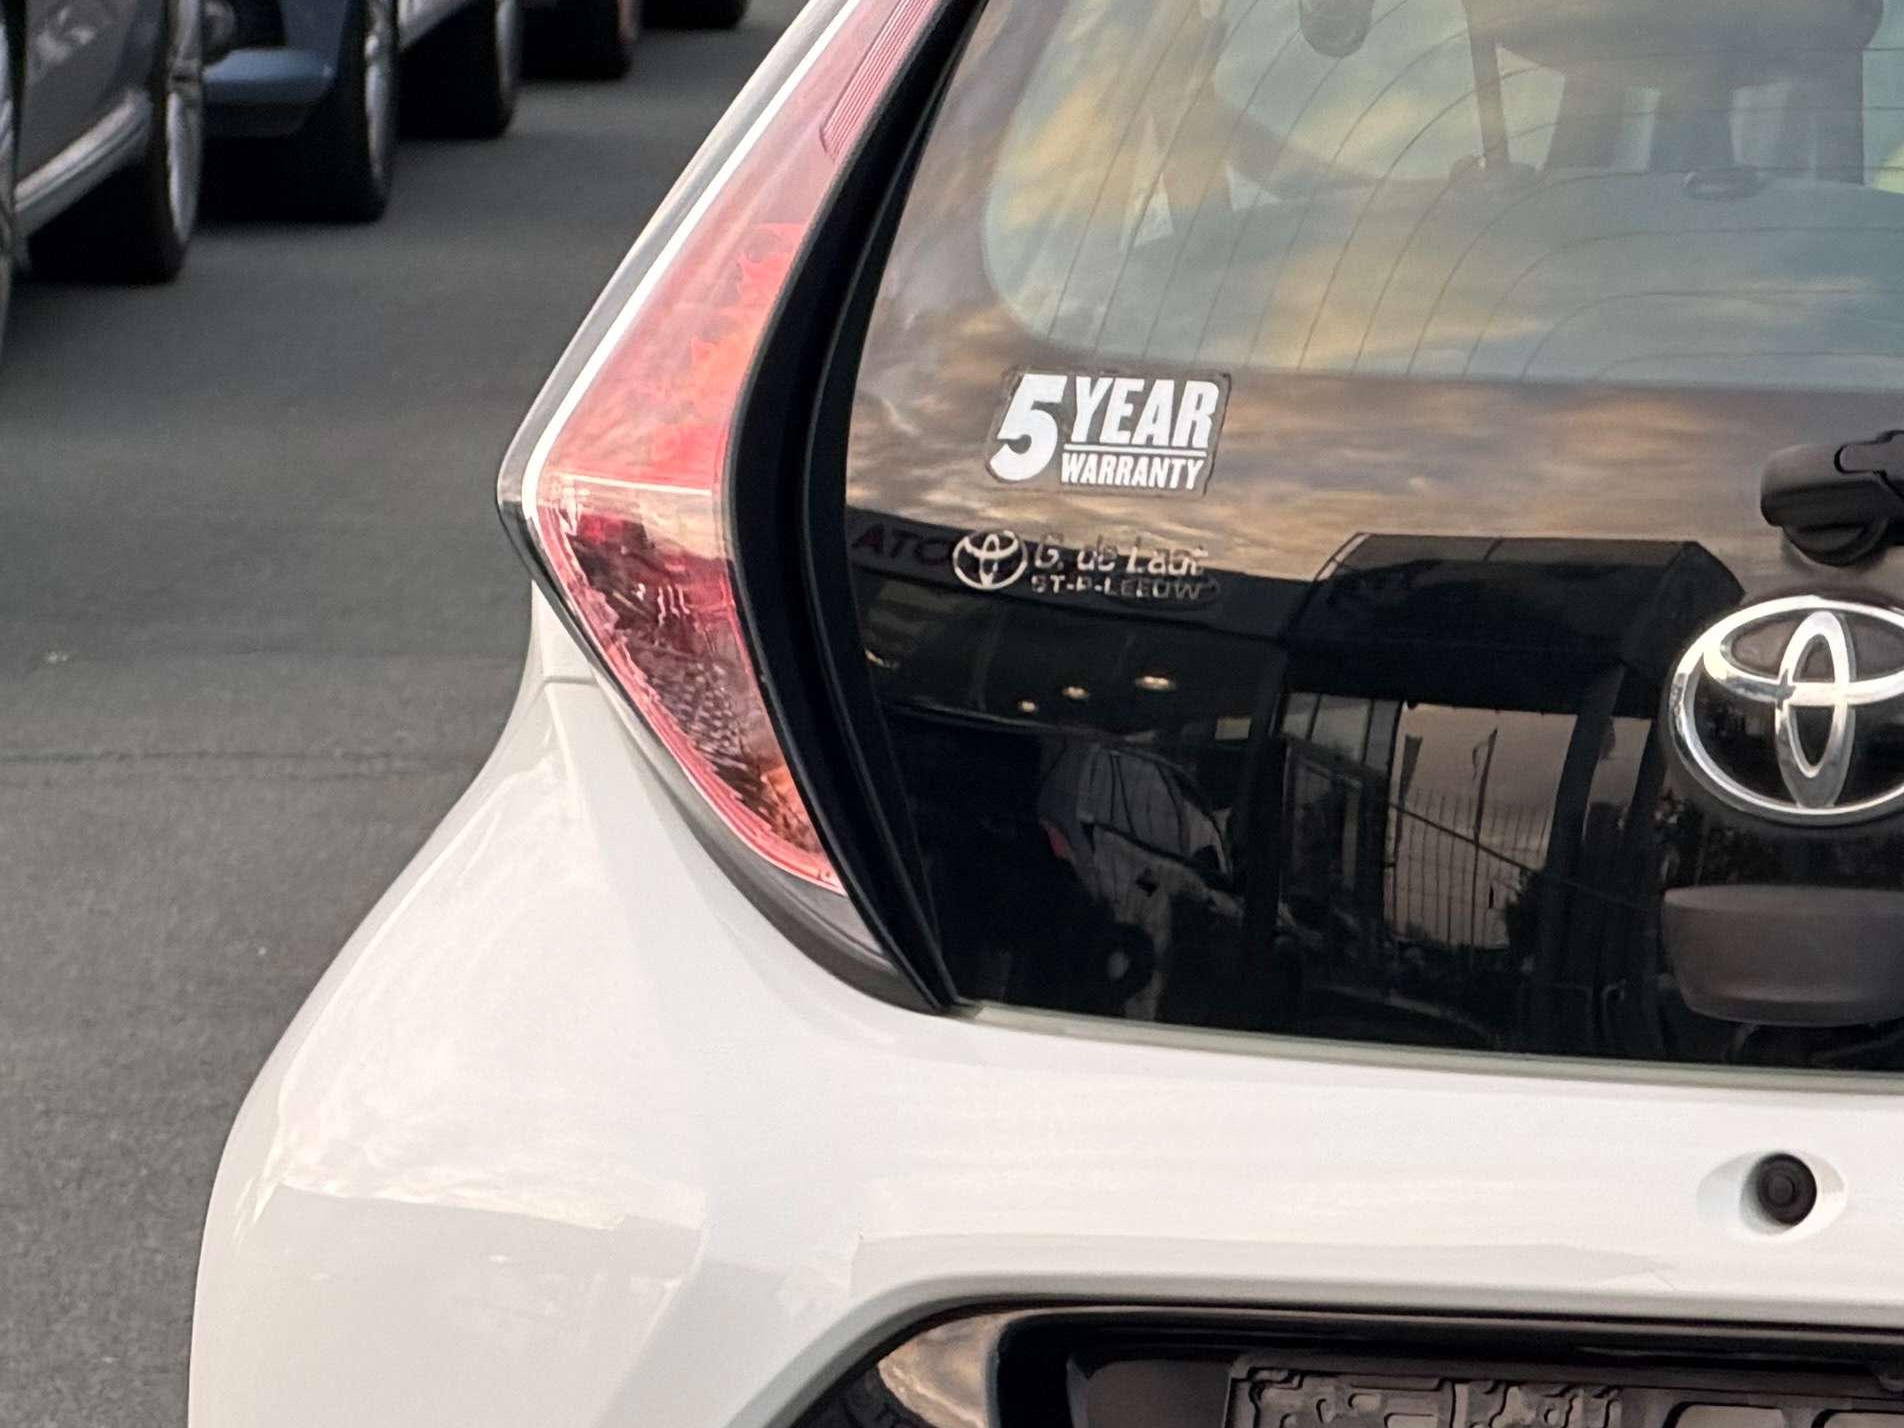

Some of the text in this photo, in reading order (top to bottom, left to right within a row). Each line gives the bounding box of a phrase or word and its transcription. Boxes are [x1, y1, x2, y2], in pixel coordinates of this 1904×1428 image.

[989, 373, 1220, 481] 5 YEAR
[1060, 452, 1204, 490] WARRANTY
